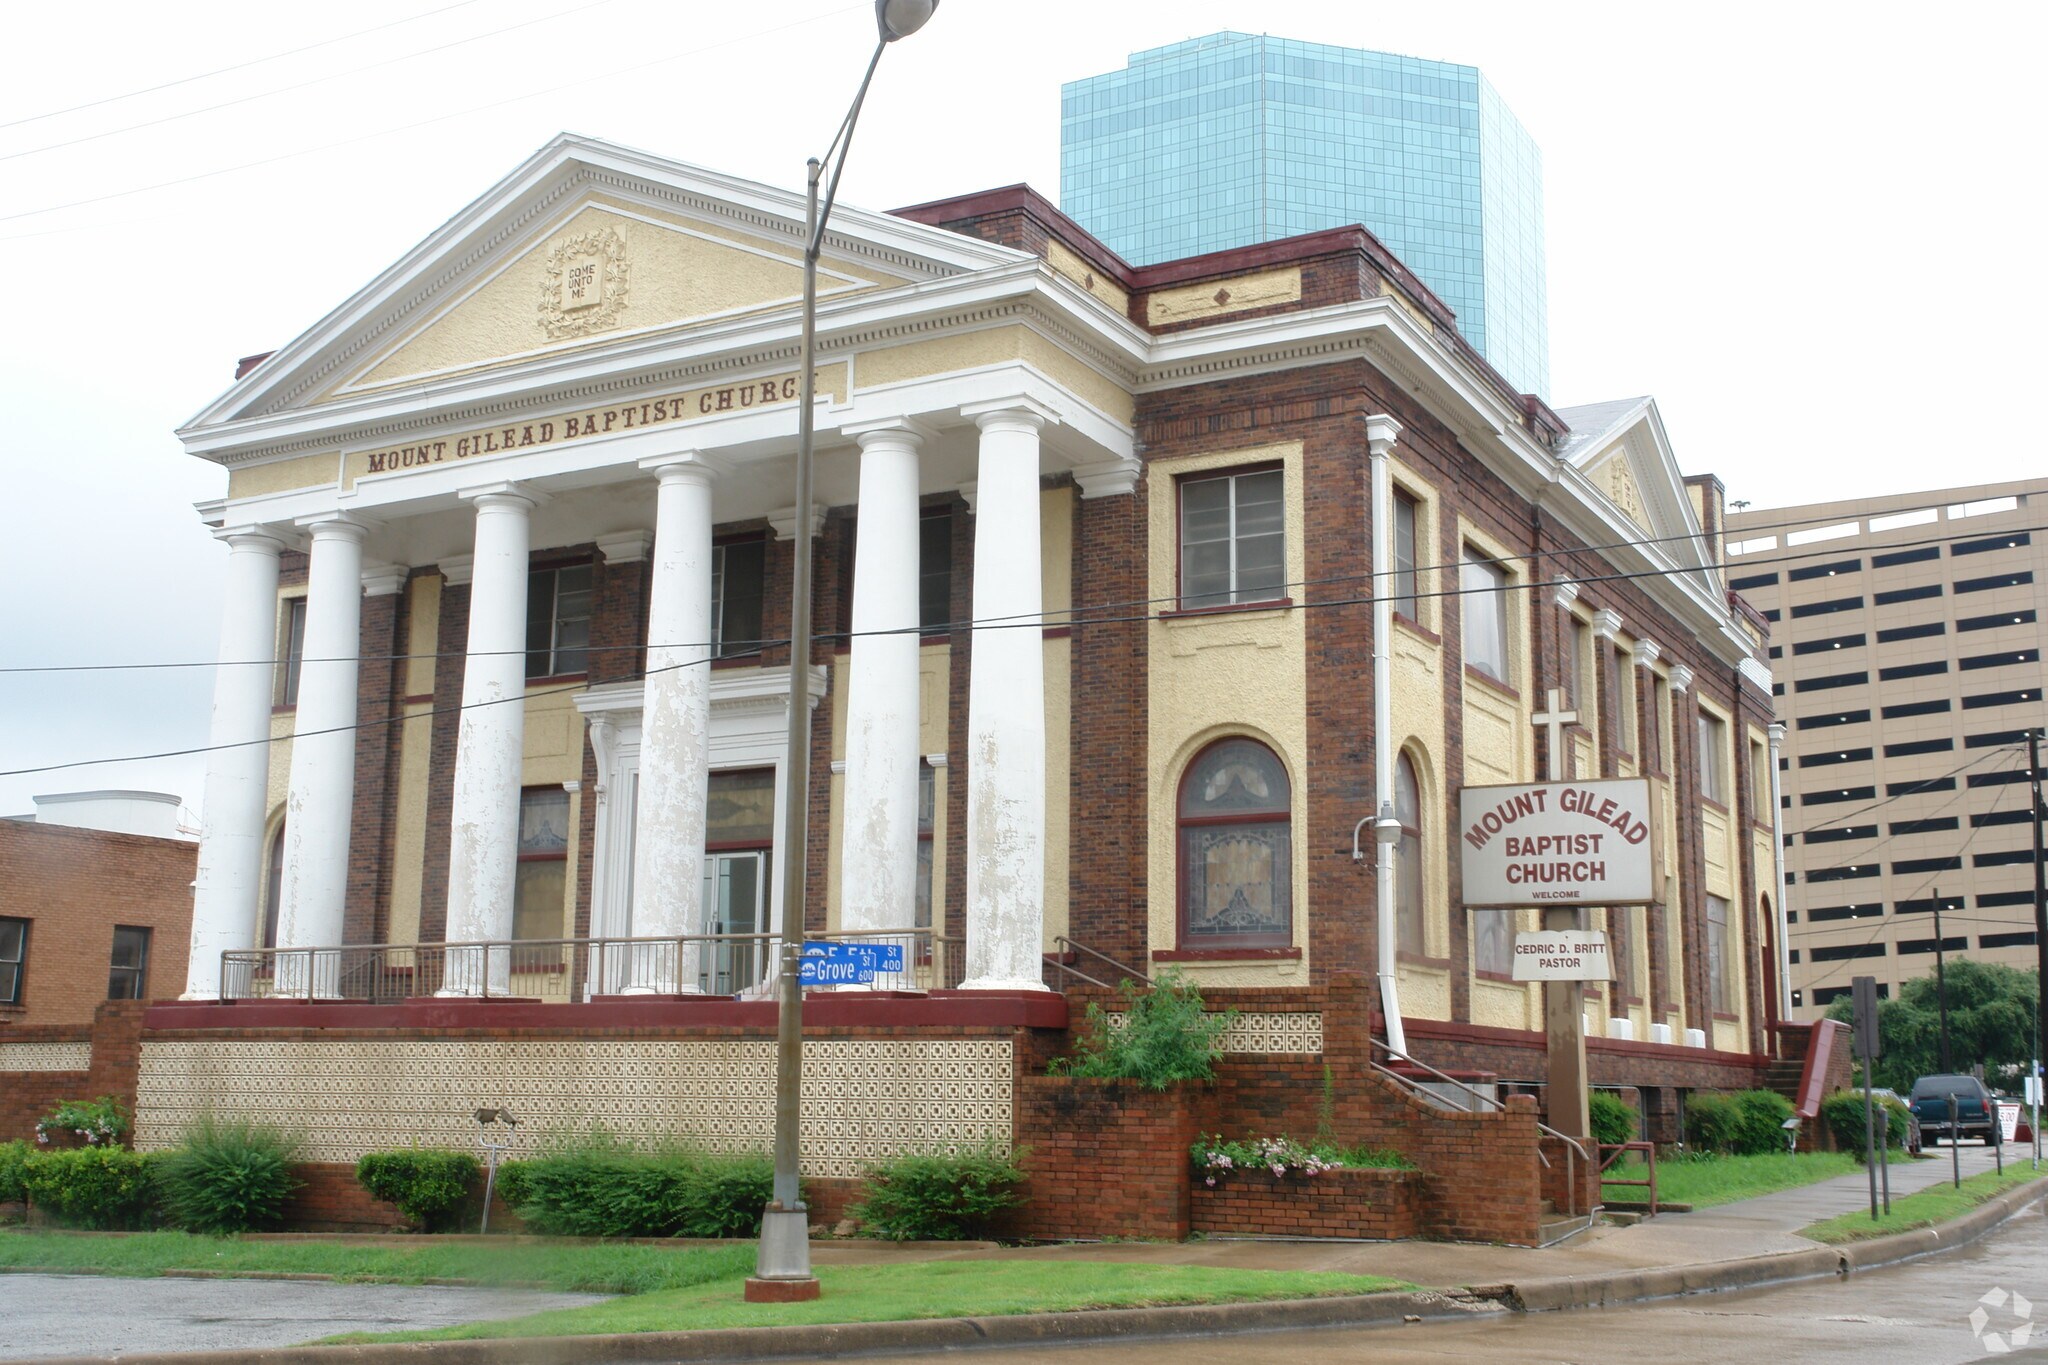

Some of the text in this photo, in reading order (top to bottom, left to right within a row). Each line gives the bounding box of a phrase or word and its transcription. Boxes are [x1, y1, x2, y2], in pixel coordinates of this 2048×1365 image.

[569, 264, 596, 279] COME
[568, 275, 593, 289] UNTO
[571, 287, 585, 299] ME
[367, 372, 819, 473] MOUNT GILEAD BAPTIST CHURC
[1464, 788, 1649, 851] MOUNT GILEAD
[1505, 834, 1604, 857] BAPTIST
[1506, 861, 1606, 884] CHURCH
[1532, 890, 1580, 899] WELCOME
[887, 946, 897, 957] St
[1515, 943, 1605, 954] CEDRIC D. BRITT
[817, 955, 871, 981] Grove St
[882, 960, 901, 971] 400
[1539, 958, 1581, 968] PASTOR
[858, 970, 873, 981] 600
